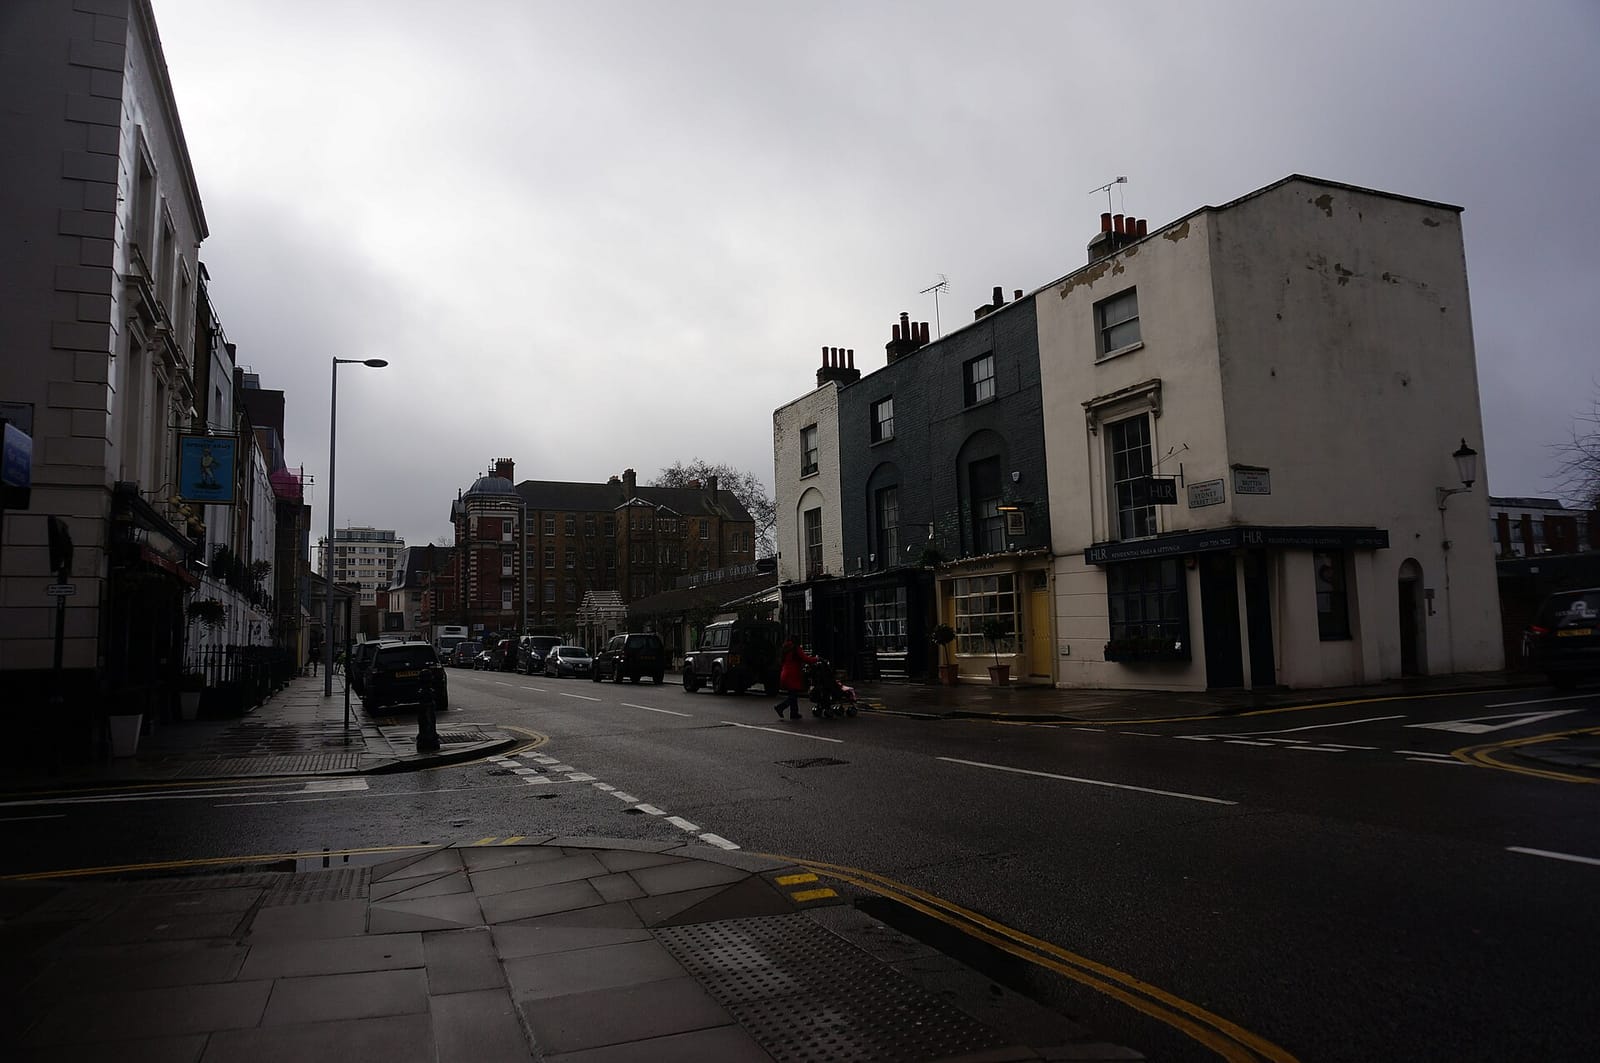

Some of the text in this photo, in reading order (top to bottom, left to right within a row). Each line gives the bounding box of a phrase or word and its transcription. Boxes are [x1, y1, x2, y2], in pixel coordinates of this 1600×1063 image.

[1150, 484, 1173, 498] HLR
[1194, 491, 1217, 499] SYDNEY
[1242, 530, 1263, 544] HLR
[1090, 549, 1107, 561] HLR
[866, 621, 908, 636] SALE
